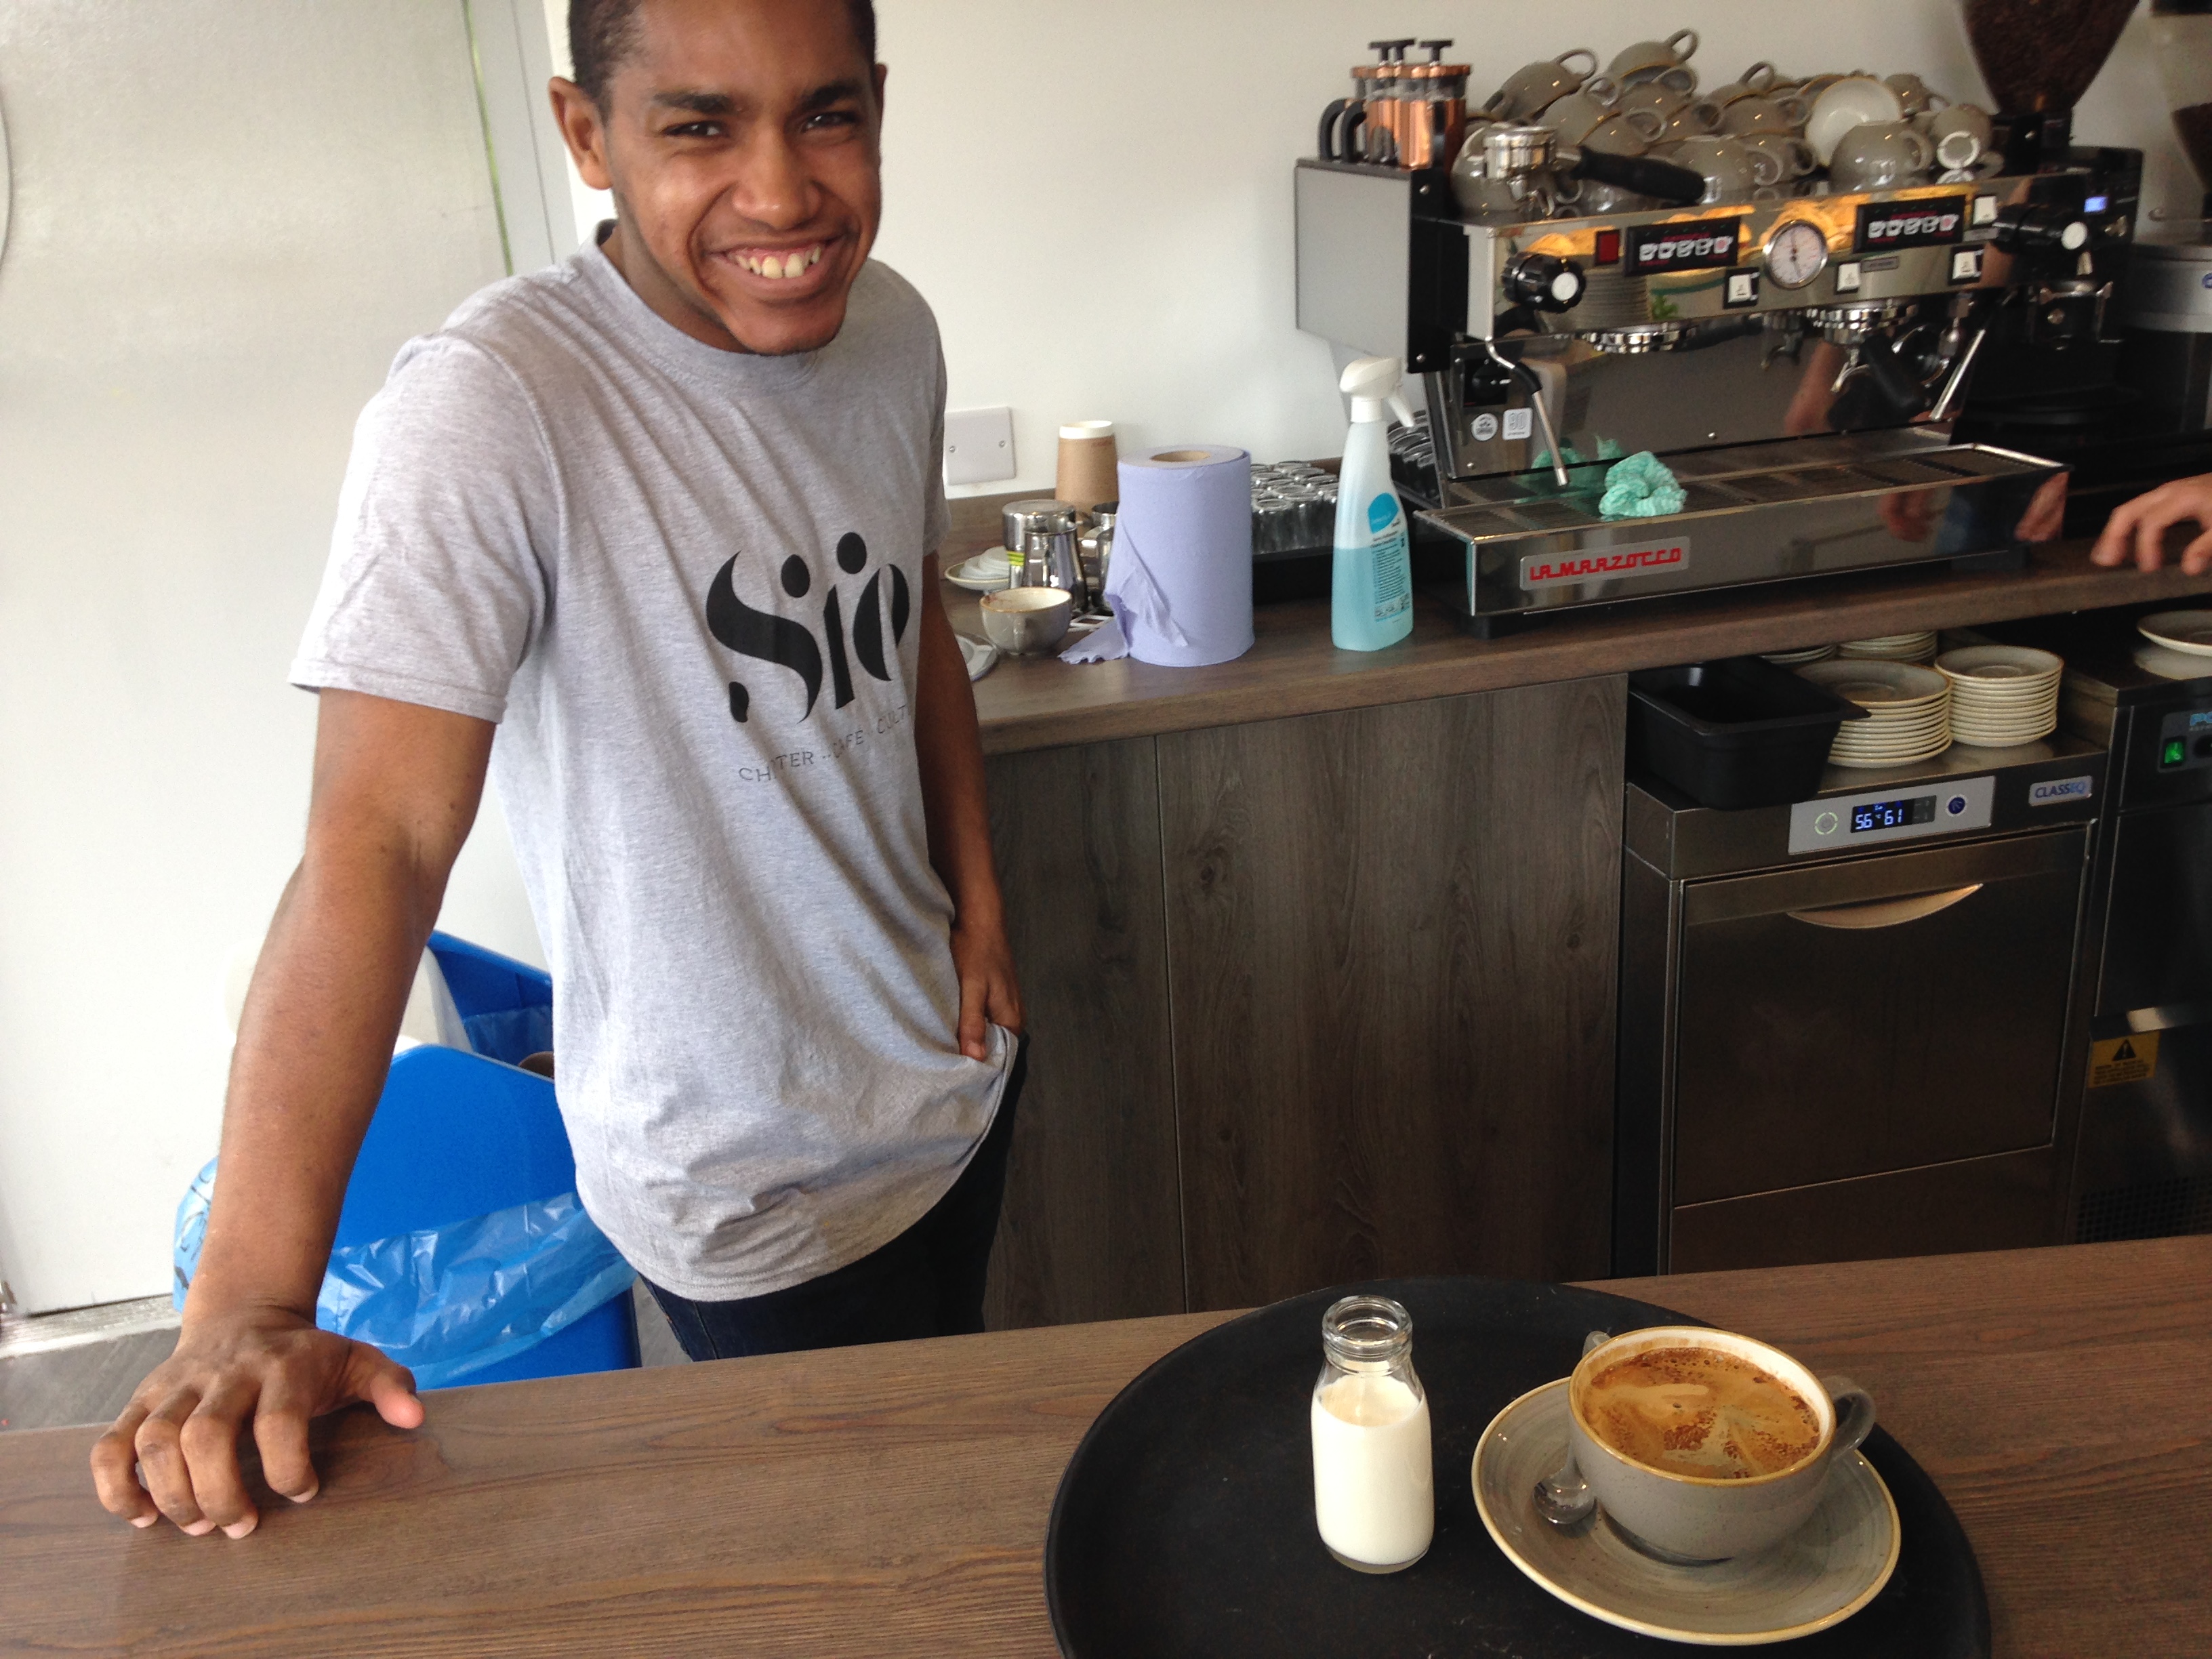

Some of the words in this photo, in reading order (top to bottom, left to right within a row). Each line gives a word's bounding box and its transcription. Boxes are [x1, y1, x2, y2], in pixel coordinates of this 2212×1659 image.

[1530, 565, 1553, 581] LA
[2034, 781, 2085, 798] CLASSEQ
[1855, 813, 1872, 830] 56
[1884, 808, 1903, 825] 61
